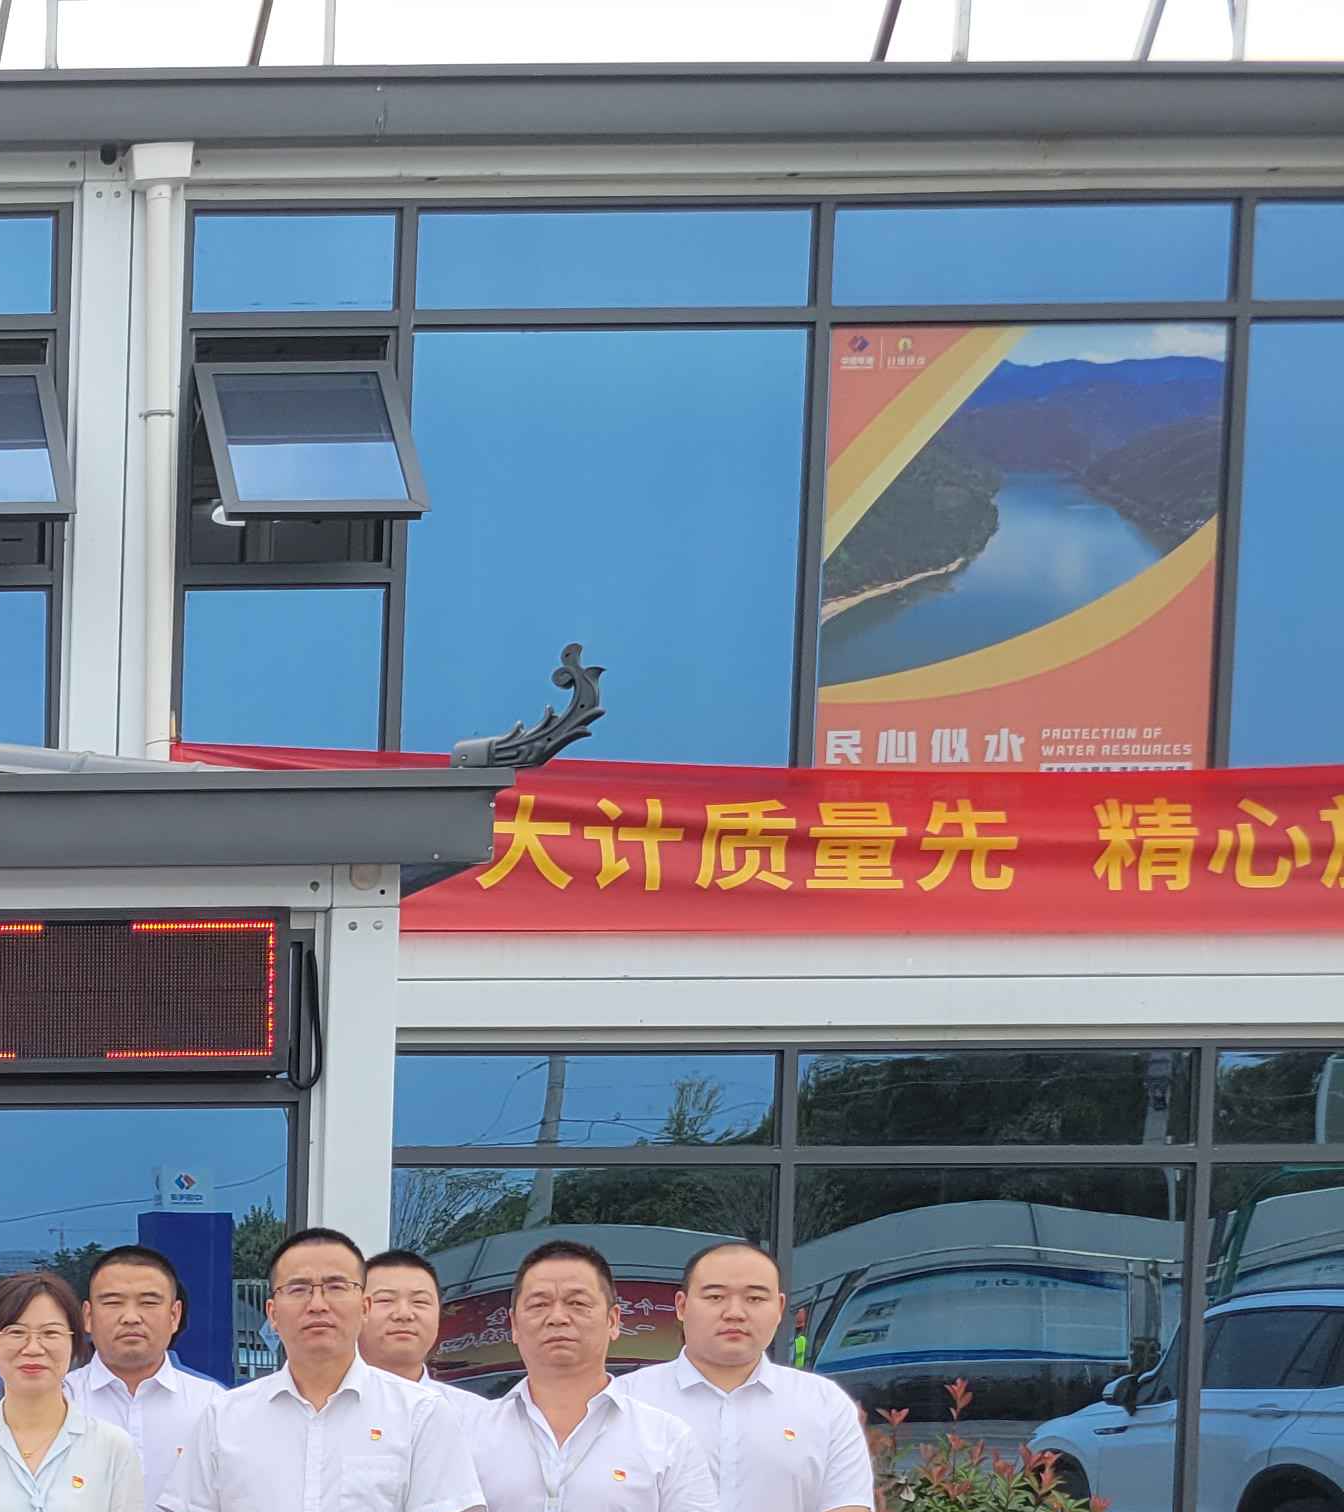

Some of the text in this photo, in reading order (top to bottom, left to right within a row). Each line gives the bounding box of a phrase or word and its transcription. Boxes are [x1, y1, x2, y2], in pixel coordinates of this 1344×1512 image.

[824, 728, 1026, 765] 民心似水
[1041, 728, 1162, 740] PROTECTION OF
[1041, 744, 1193, 757] WATER RESOURCES
[476, 796, 1018, 893] 大计质量先
